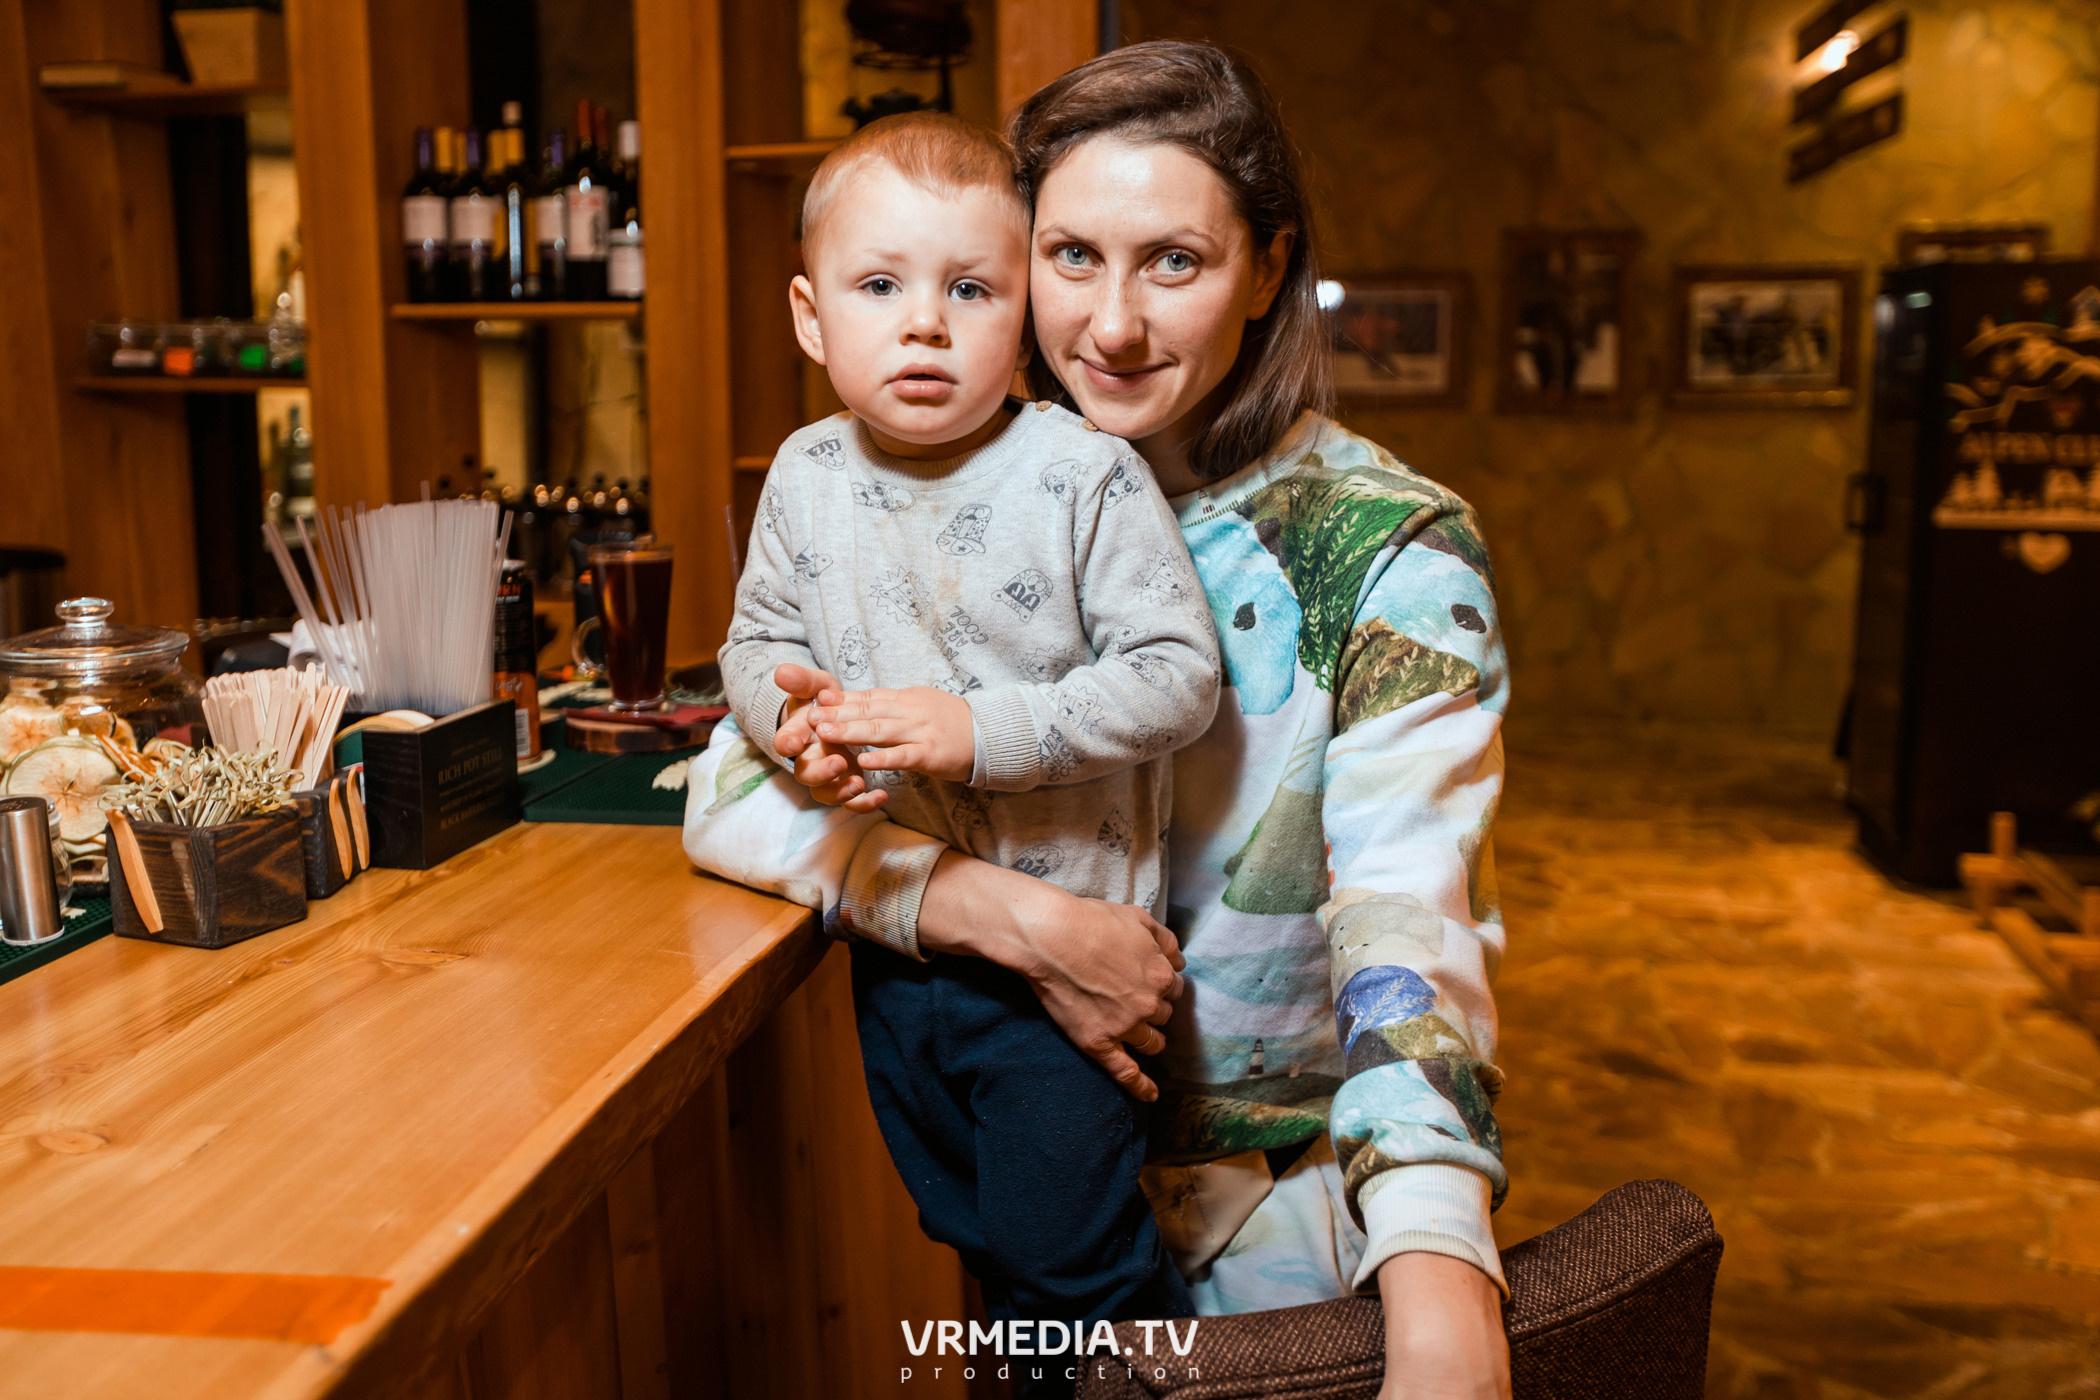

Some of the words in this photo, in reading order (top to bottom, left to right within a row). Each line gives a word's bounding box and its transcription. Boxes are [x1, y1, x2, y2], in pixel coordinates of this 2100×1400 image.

[939, 621, 969, 647] ARE
[950, 604, 989, 645] COOL
[438, 761, 461, 785] RICH
